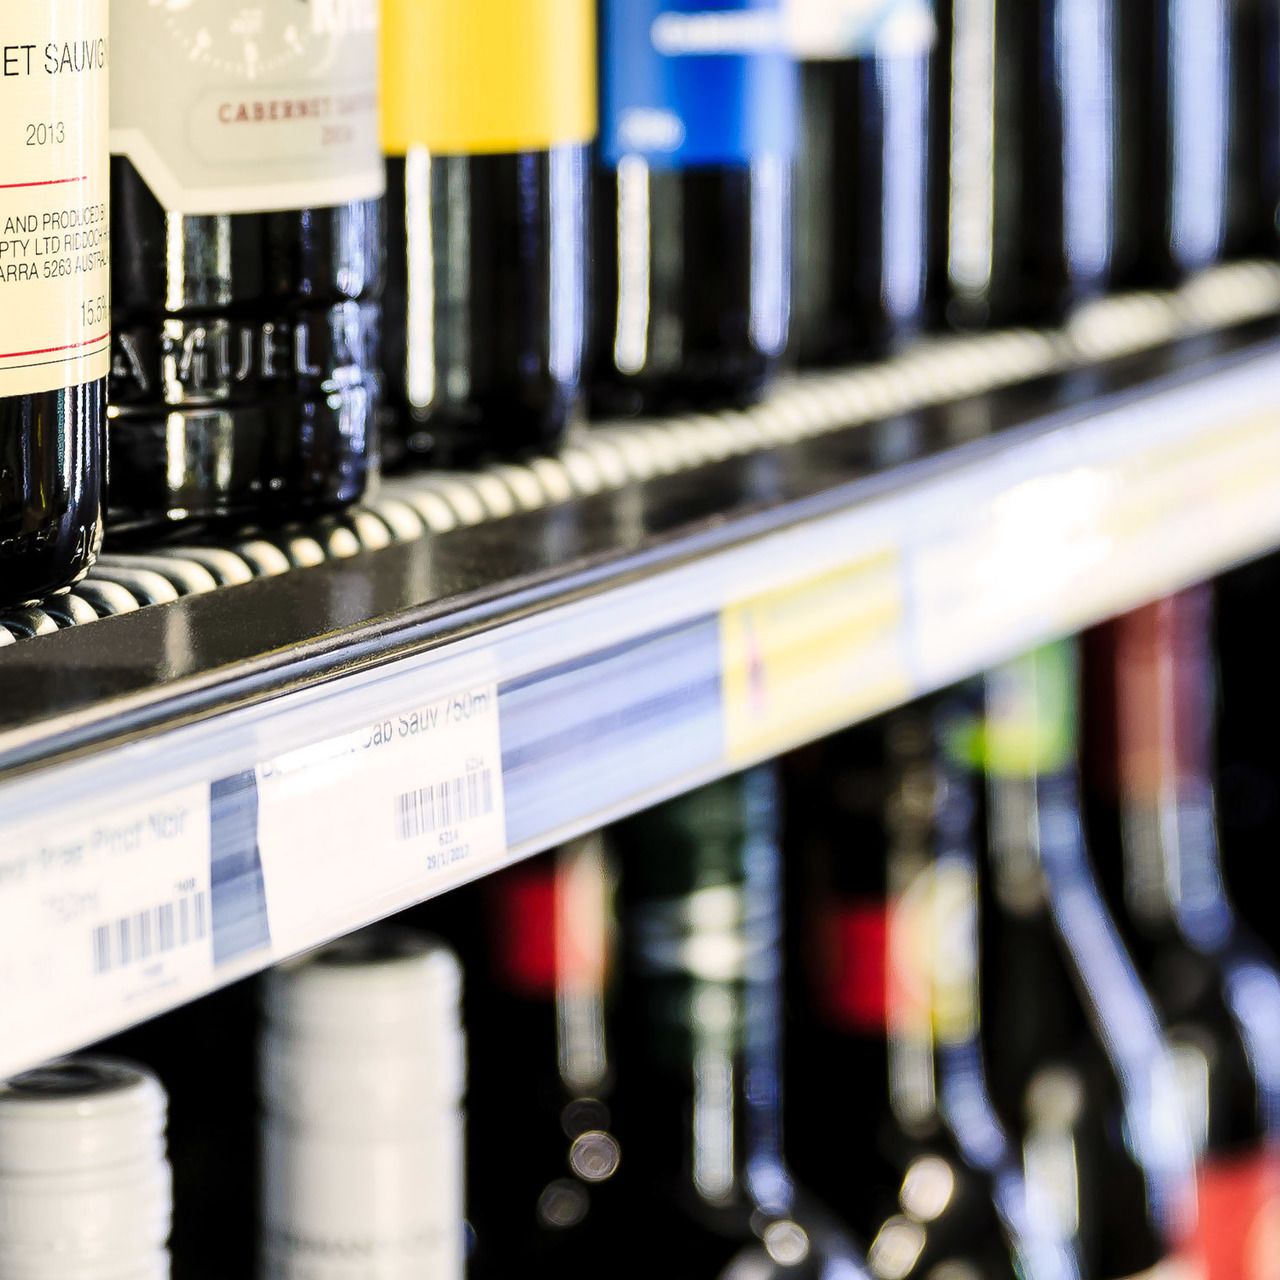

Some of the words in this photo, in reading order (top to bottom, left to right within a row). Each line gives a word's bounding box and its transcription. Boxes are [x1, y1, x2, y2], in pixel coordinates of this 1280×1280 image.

[218, 97, 331, 124] CABERNET
[26, 121, 66, 147] 2013
[4, 214, 38, 235] AND
[42, 205, 100, 232] PRODUCED
[0, 239, 30, 259] PTY
[35, 235, 61, 256] LTD
[43, 257, 72, 279] 5263
[112, 323, 320, 391] AMUEL
[398, 707, 439, 738] Sauv
